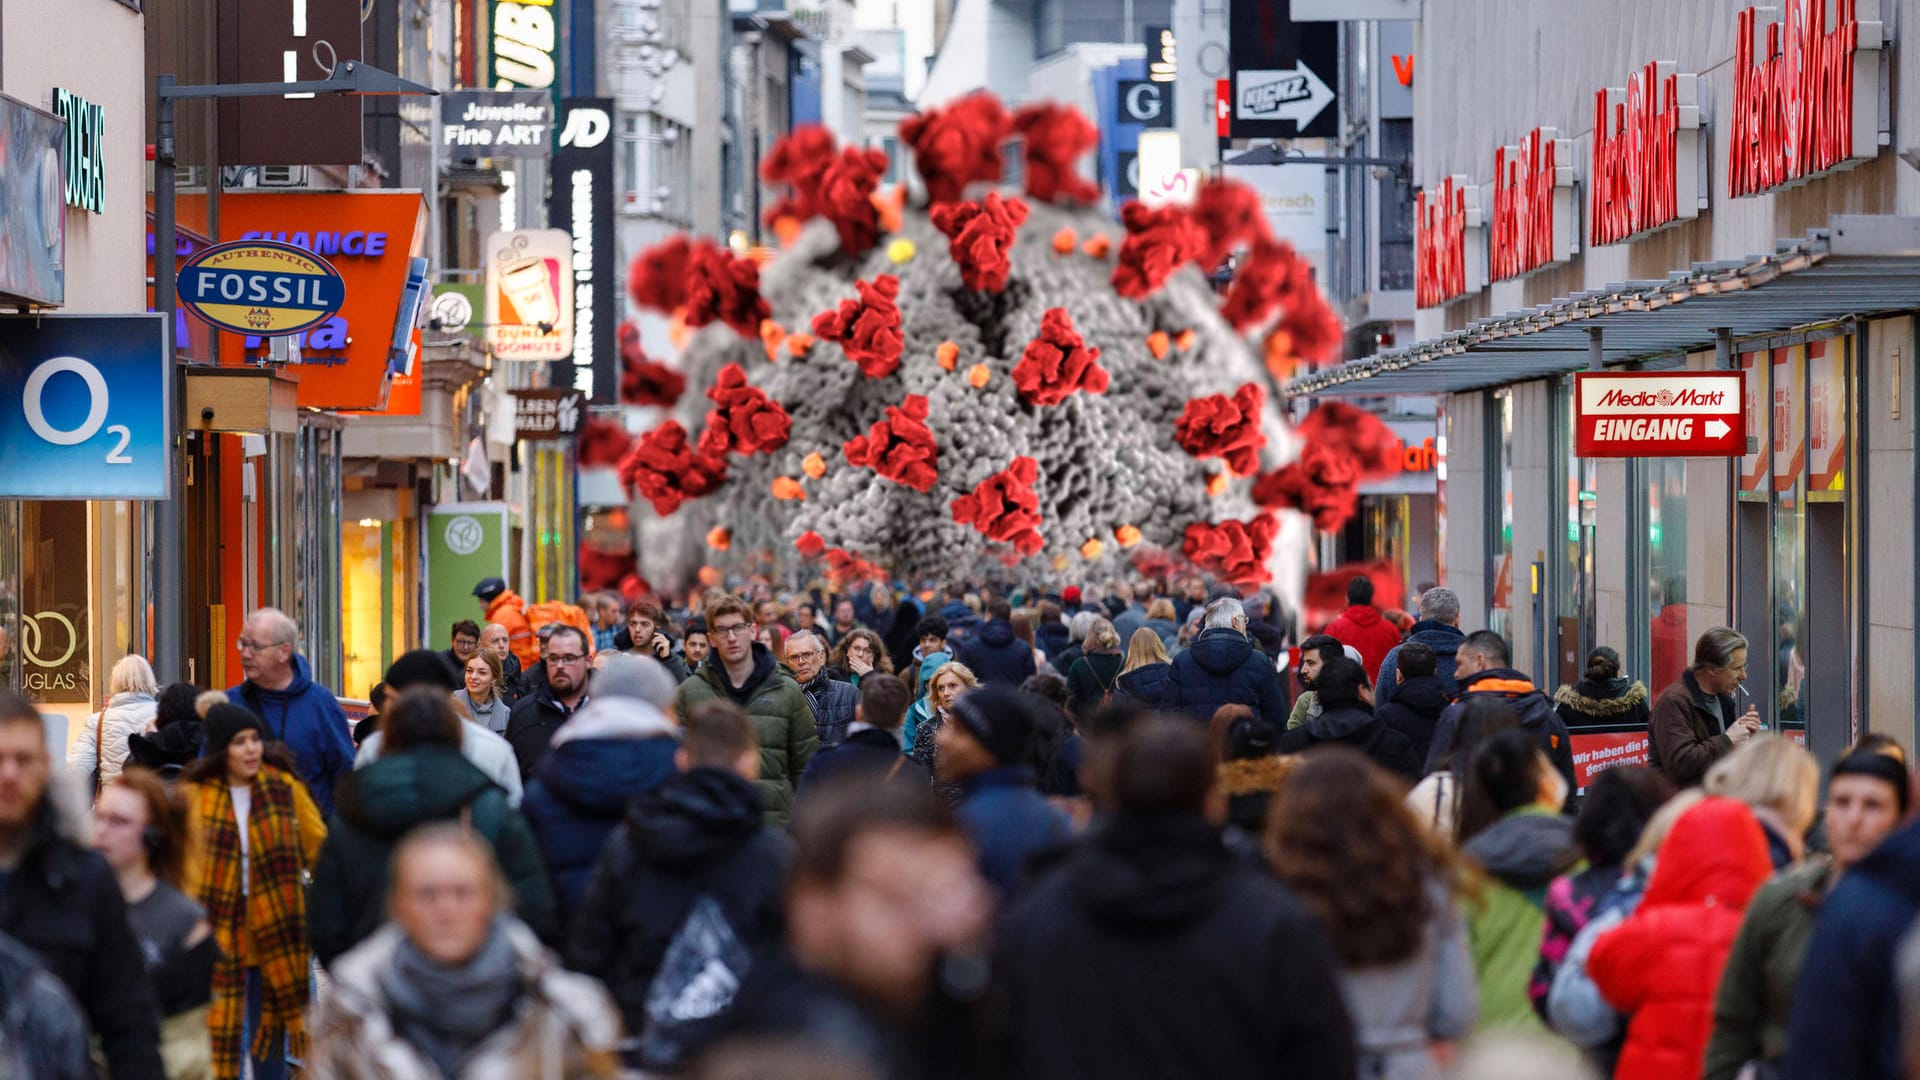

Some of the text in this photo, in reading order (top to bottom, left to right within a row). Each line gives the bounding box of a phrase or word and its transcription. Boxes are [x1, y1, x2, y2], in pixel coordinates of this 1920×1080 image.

[462, 103, 545, 121] Juwelier
[1126, 84, 1162, 120] G
[443, 124, 492, 146] Fine
[495, 125, 546, 146] ART
[559, 108, 610, 148] JD
[55, 87, 105, 214] OUGLAS
[211, 249, 315, 272] AUTHENTIC
[197, 271, 329, 306] FOSSIL
[497, 342, 562, 353] DONUTS
[1597, 388, 1725, 408] Media Markt
[1593, 418, 1694, 441] EINGANG
[1572, 738, 1649, 765] Wir haben die P
[1586, 755, 1642, 777] gestrichen,
